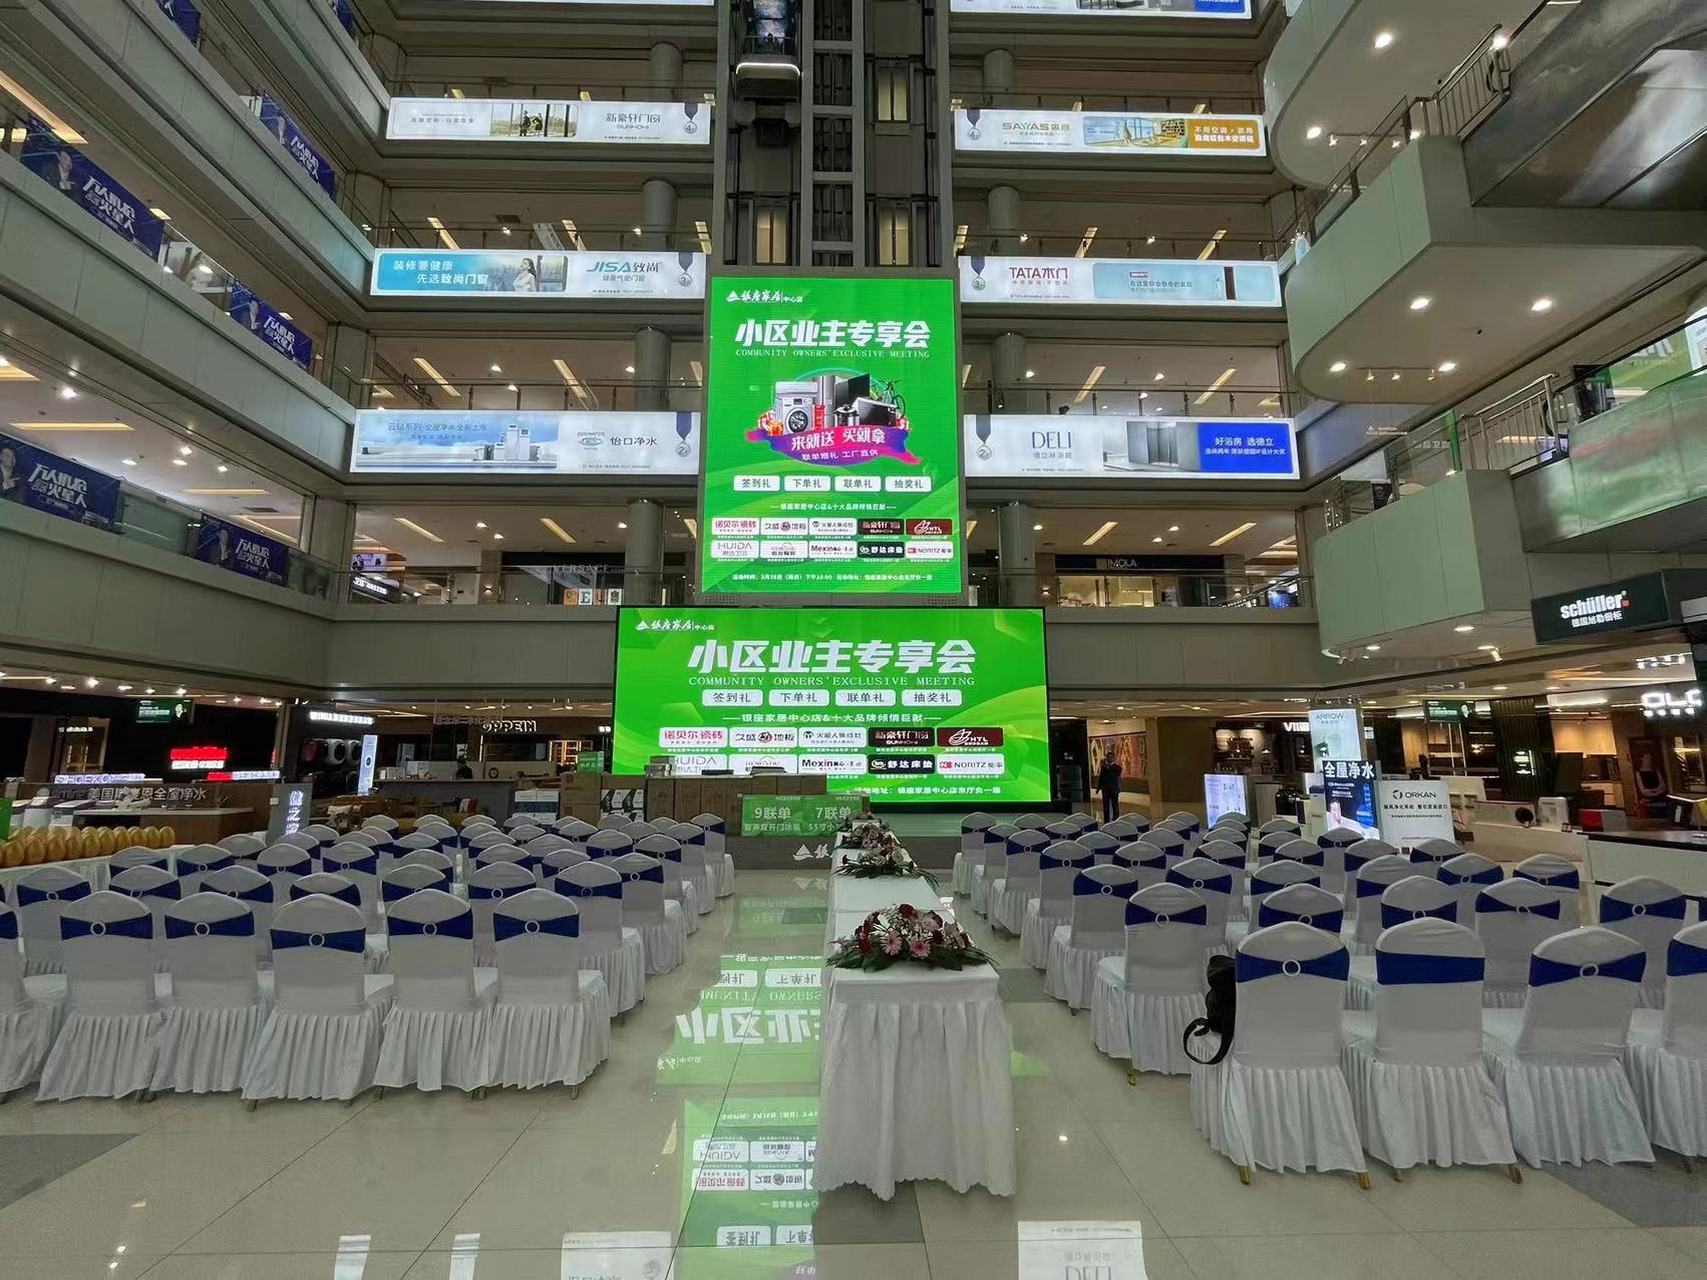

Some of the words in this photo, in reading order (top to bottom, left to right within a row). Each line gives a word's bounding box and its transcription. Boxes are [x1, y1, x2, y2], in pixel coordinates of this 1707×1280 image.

[393, 260, 454, 271] 装修要健康
[586, 262, 631, 272] JISA
[633, 262, 659, 272] 致尚
[417, 274, 489, 285] 先选致尚门窗
[735, 319, 931, 348] 小区业主专享会
[735, 349, 787, 357] COMMUNITY
[833, 349, 885, 358] EXCLUSIVE
[890, 350, 930, 358] MEETING
[610, 436, 657, 446] 怡口净水
[791, 430, 835, 451] 来就送
[843, 427, 886, 444] 买就拿
[1032, 431, 1072, 449] DELI
[742, 478, 771, 488] 签到礼
[792, 478, 822, 488] 下单礼
[843, 478, 873, 489] 联单礼
[894, 479, 924, 489] 抽奖礼
[687, 639, 977, 673] 小区业主专享会
[688, 676, 764, 686] COMMUNITY
[833, 676, 908, 686] EXCLUSIVE
[916, 676, 975, 686] MEETING
[712, 692, 751, 703] 签到礼
[780, 692, 817, 703] 下单礼
[847, 692, 885, 703] 联单礼
[914, 692, 951, 703] 抽奖礼
[742, 713, 923, 723] 银座家居中心店&十大品牌倾情巨献
[1316, 712, 1345, 721] ARROW
[482, 719, 537, 733] OPPEIN
[664, 730, 723, 740] 诺贝尔瓷砖
[735, 733, 756, 742] 久盛
[774, 733, 795, 742] 地板
[802, 759, 833, 767] Mexin
[888, 760, 933, 768] 舒达床垫
[1324, 762, 1375, 779] 全屋净水
[1405, 791, 1437, 799] ORKAN
[754, 807, 792, 820] 9联单
[815, 807, 852, 820] 7联单
